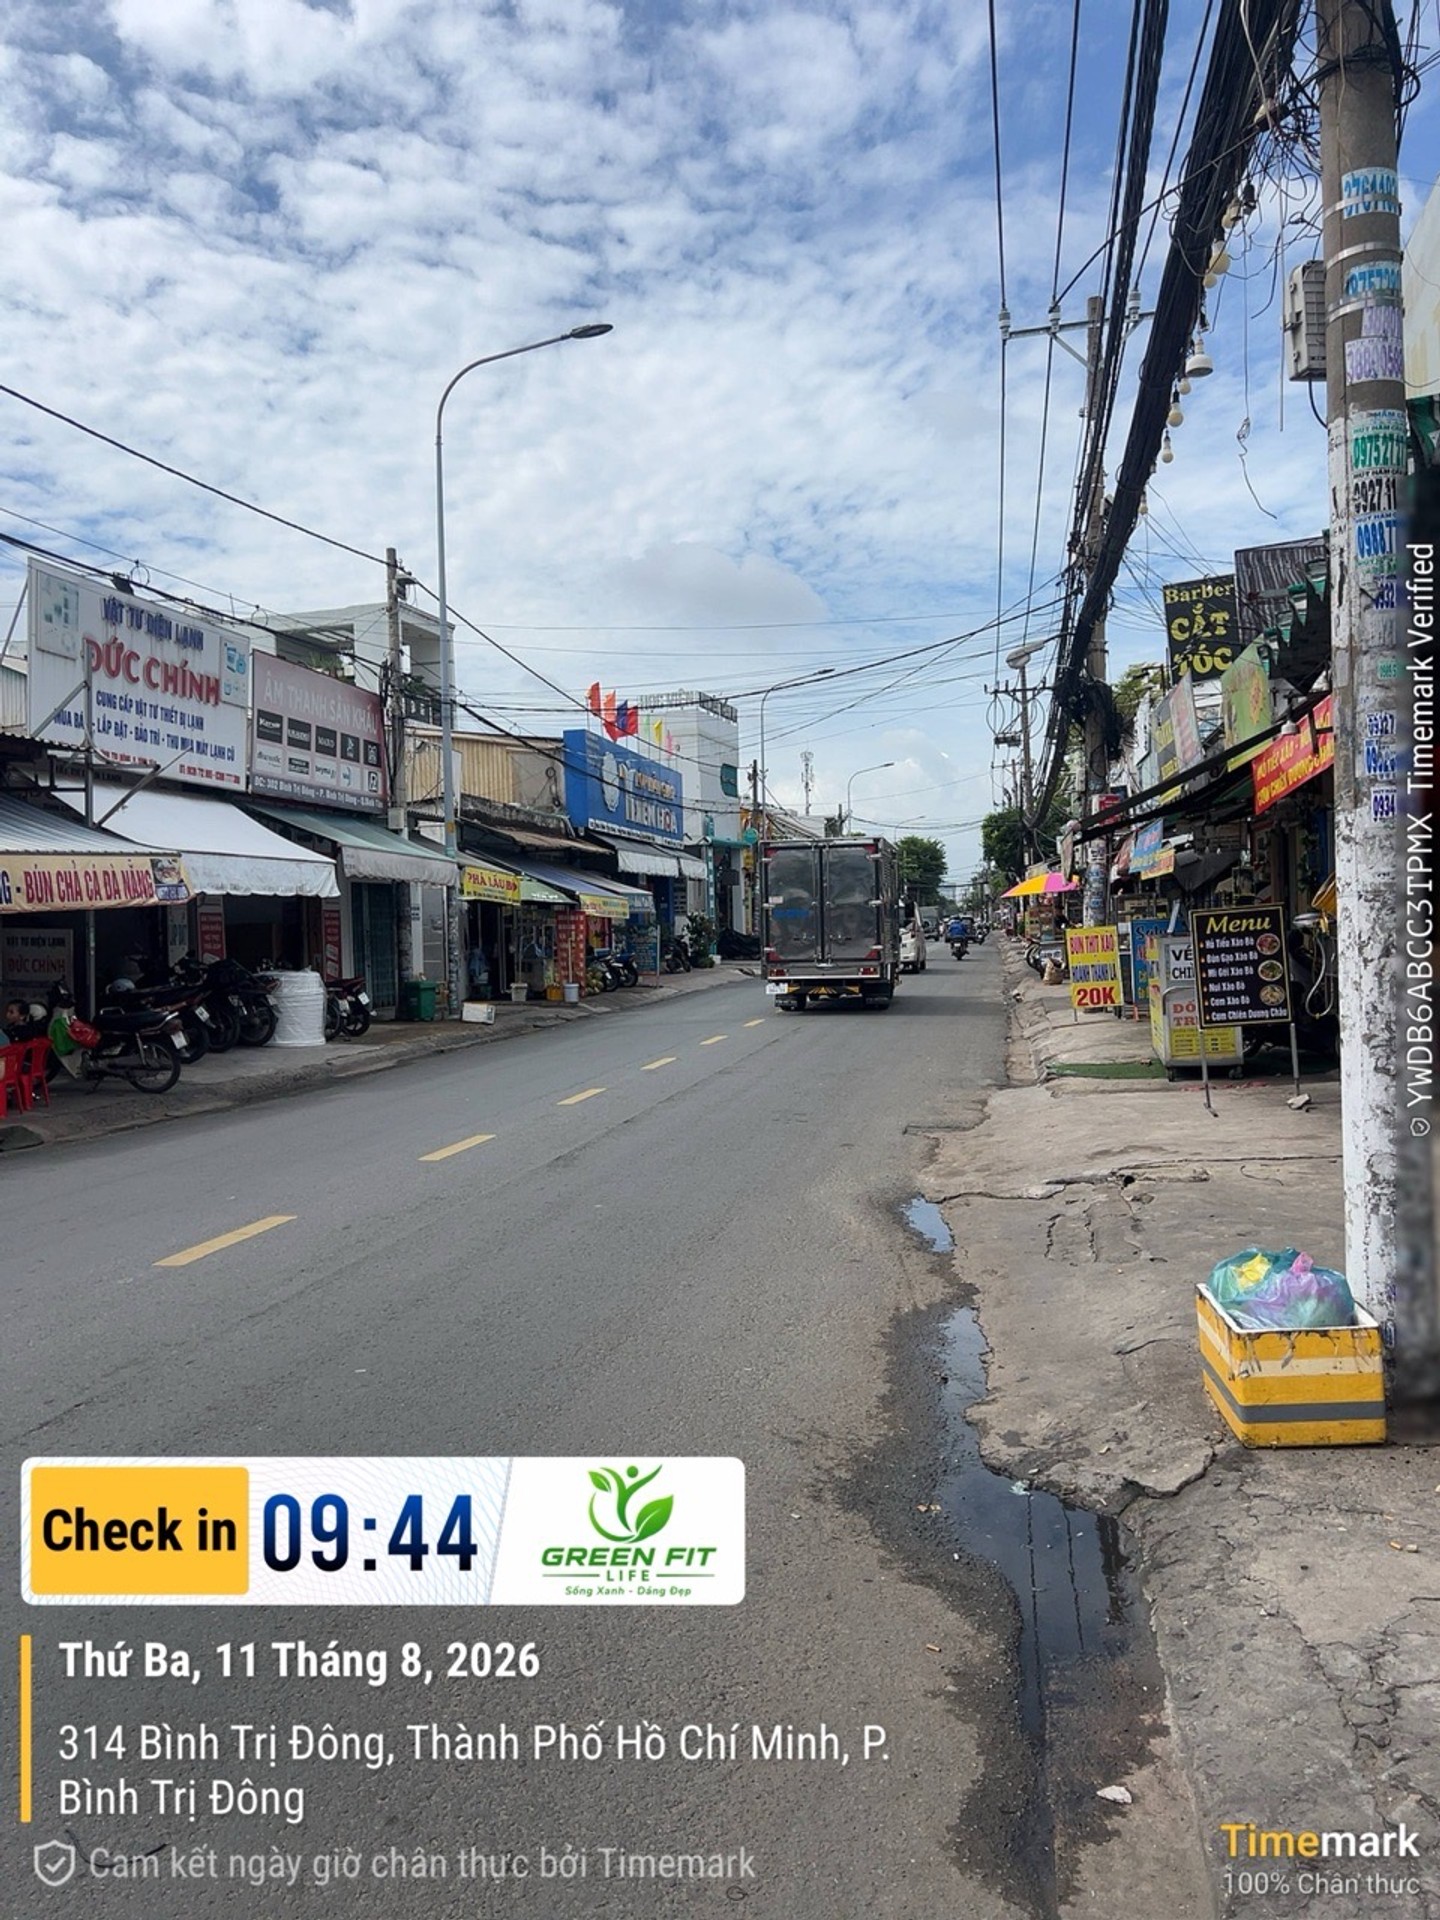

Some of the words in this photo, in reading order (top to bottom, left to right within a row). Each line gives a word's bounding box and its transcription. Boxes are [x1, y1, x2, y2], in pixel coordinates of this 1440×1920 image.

[1165, 583, 1234, 604] Barber
[1170, 602, 1230, 641] CẮT
[84, 636, 140, 684] ĐỨC
[143, 657, 220, 707] CHÍNH
[1172, 643, 1233, 676] TÓC
[96, 690, 118, 709] CUNG
[119, 692, 134, 714] CẤP
[135, 698, 148, 720] VẬT
[149, 702, 159, 720] TƯ
[160, 702, 178, 725] THIẾT
[187, 712, 204, 731] LẠNH
[287, 685, 328, 718] THANH
[97, 713, 112, 734] LẮP
[134, 722, 148, 743] BẢO
[166, 734, 179, 749] THU
[180, 736, 195, 753] MUA
[195, 738, 208, 756] MÁY
[209, 743, 226, 763] LẠNH
[23, 863, 54, 904] BÚN
[56, 859, 83, 903] CHẢ
[84, 863, 102, 901] CÁ
[102, 863, 122, 901] ĐÀ
[120, 859, 155, 900] NẴNG
[1206, 915, 1272, 935] Menu
[1076, 986, 1117, 1007] 20K
